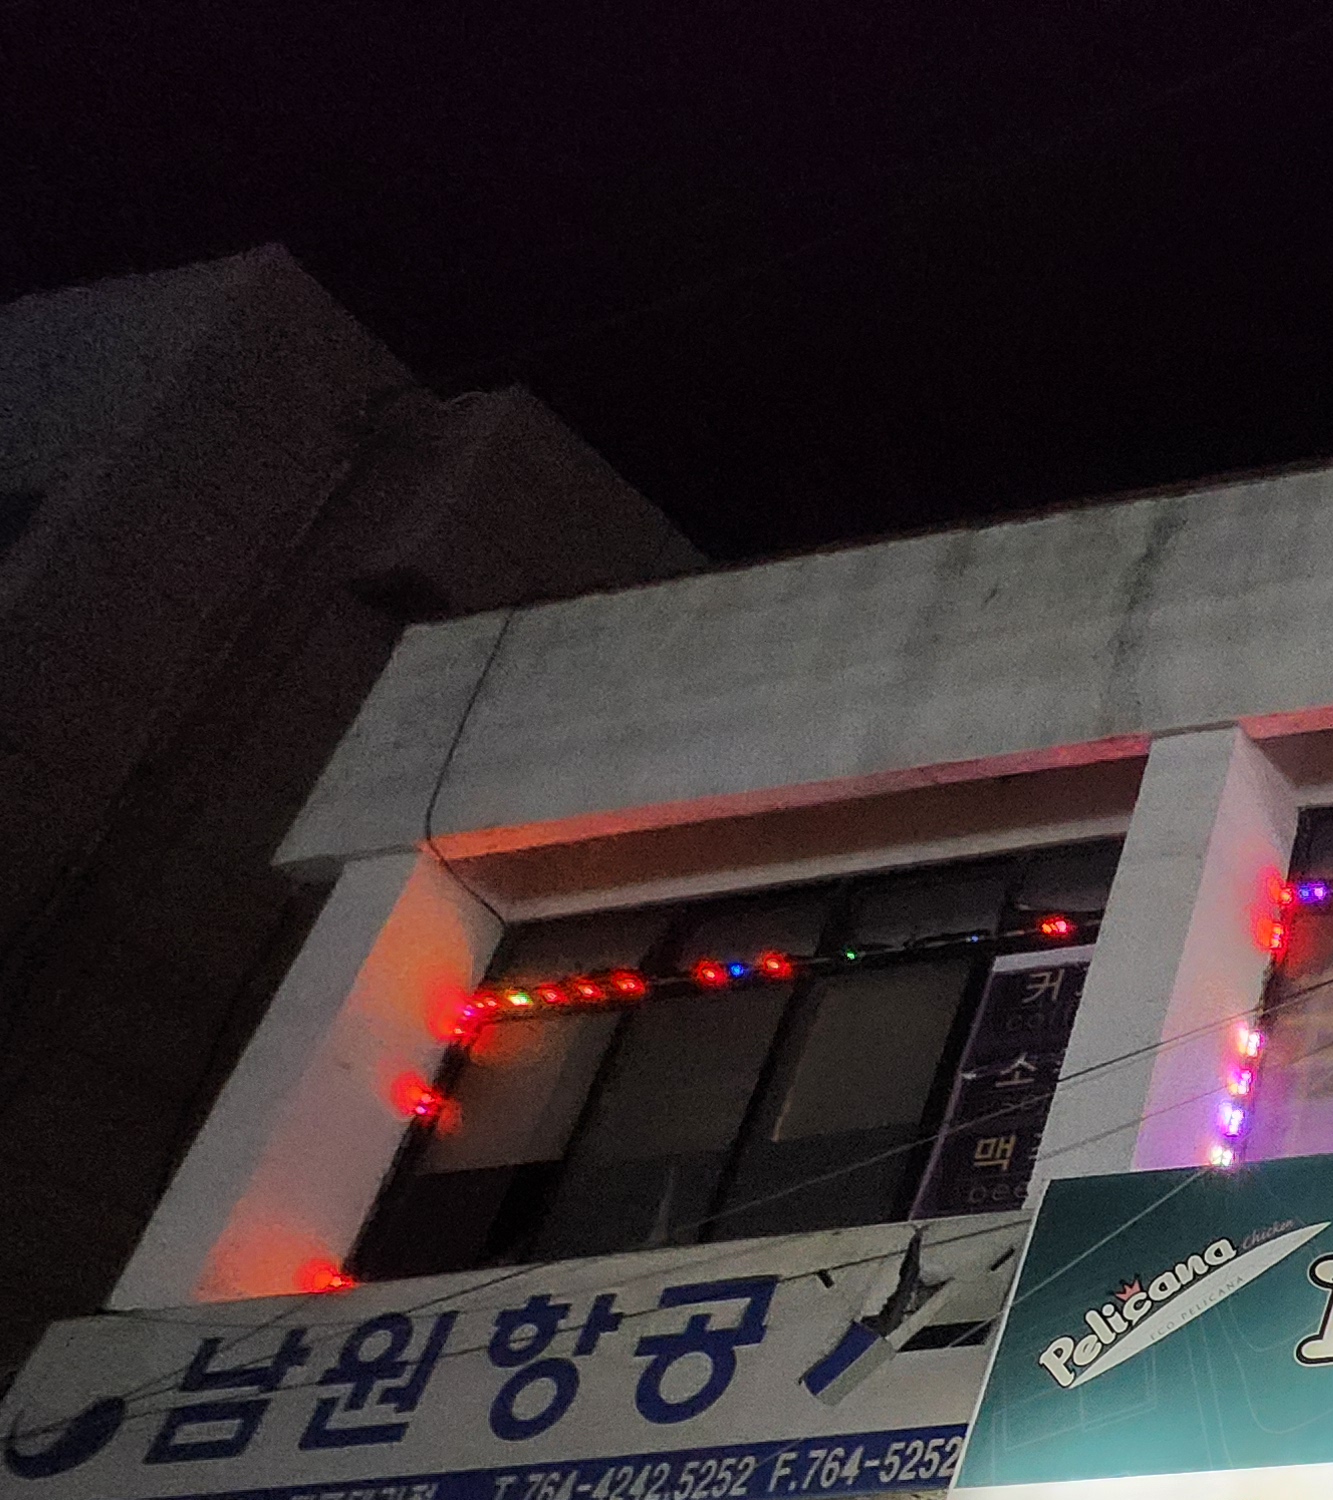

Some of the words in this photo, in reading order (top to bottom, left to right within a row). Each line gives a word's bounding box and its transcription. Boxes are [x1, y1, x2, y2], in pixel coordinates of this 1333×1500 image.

[1022, 969, 1066, 1004] 커
[1038, 1236, 1238, 1389] Pelicana
[1180, 1275, 1245, 1321] PELICANA
[143, 1272, 783, 1467] 남원항공
